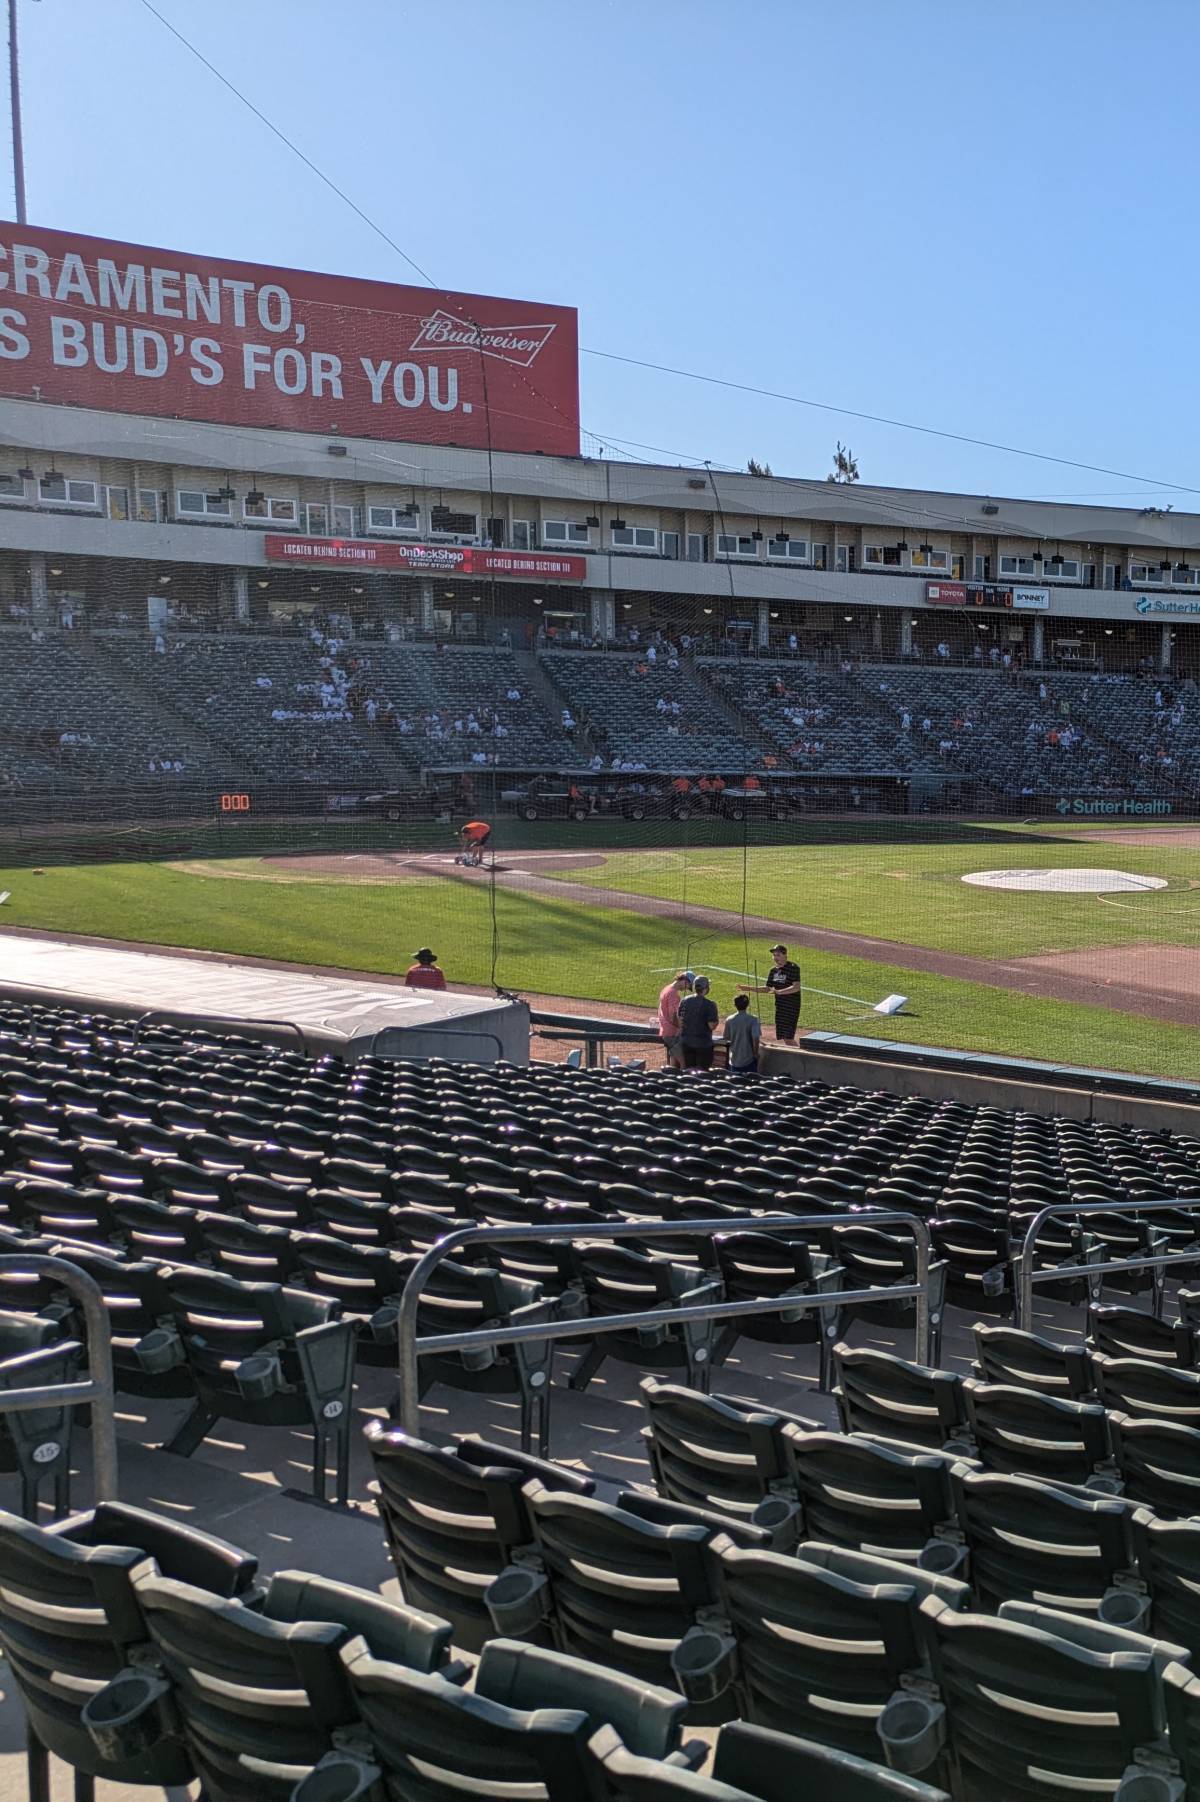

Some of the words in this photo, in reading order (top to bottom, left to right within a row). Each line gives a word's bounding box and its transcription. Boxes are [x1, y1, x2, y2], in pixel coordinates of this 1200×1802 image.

[0, 243, 305, 345] RAMENTO,
[420, 318, 544, 352] Budweiser
[51, 315, 224, 386] BUD'S
[242, 343, 344, 400] FOR
[359, 357, 472, 414] YOU.
[284, 543, 312, 555] LOCATED
[313, 545, 337, 557] BEHIND
[338, 547, 366, 559] SECTION
[513, 559, 535, 570] BEHIND
[536, 561, 561, 572] SECTION
[941, 589, 965, 598] TOYOTA
[1016, 593, 1045, 602] BONNEY
[1154, 600, 1188, 612] Sutter
[1073, 799, 1122, 814] Sutter
[1123, 799, 1171, 814] Health
